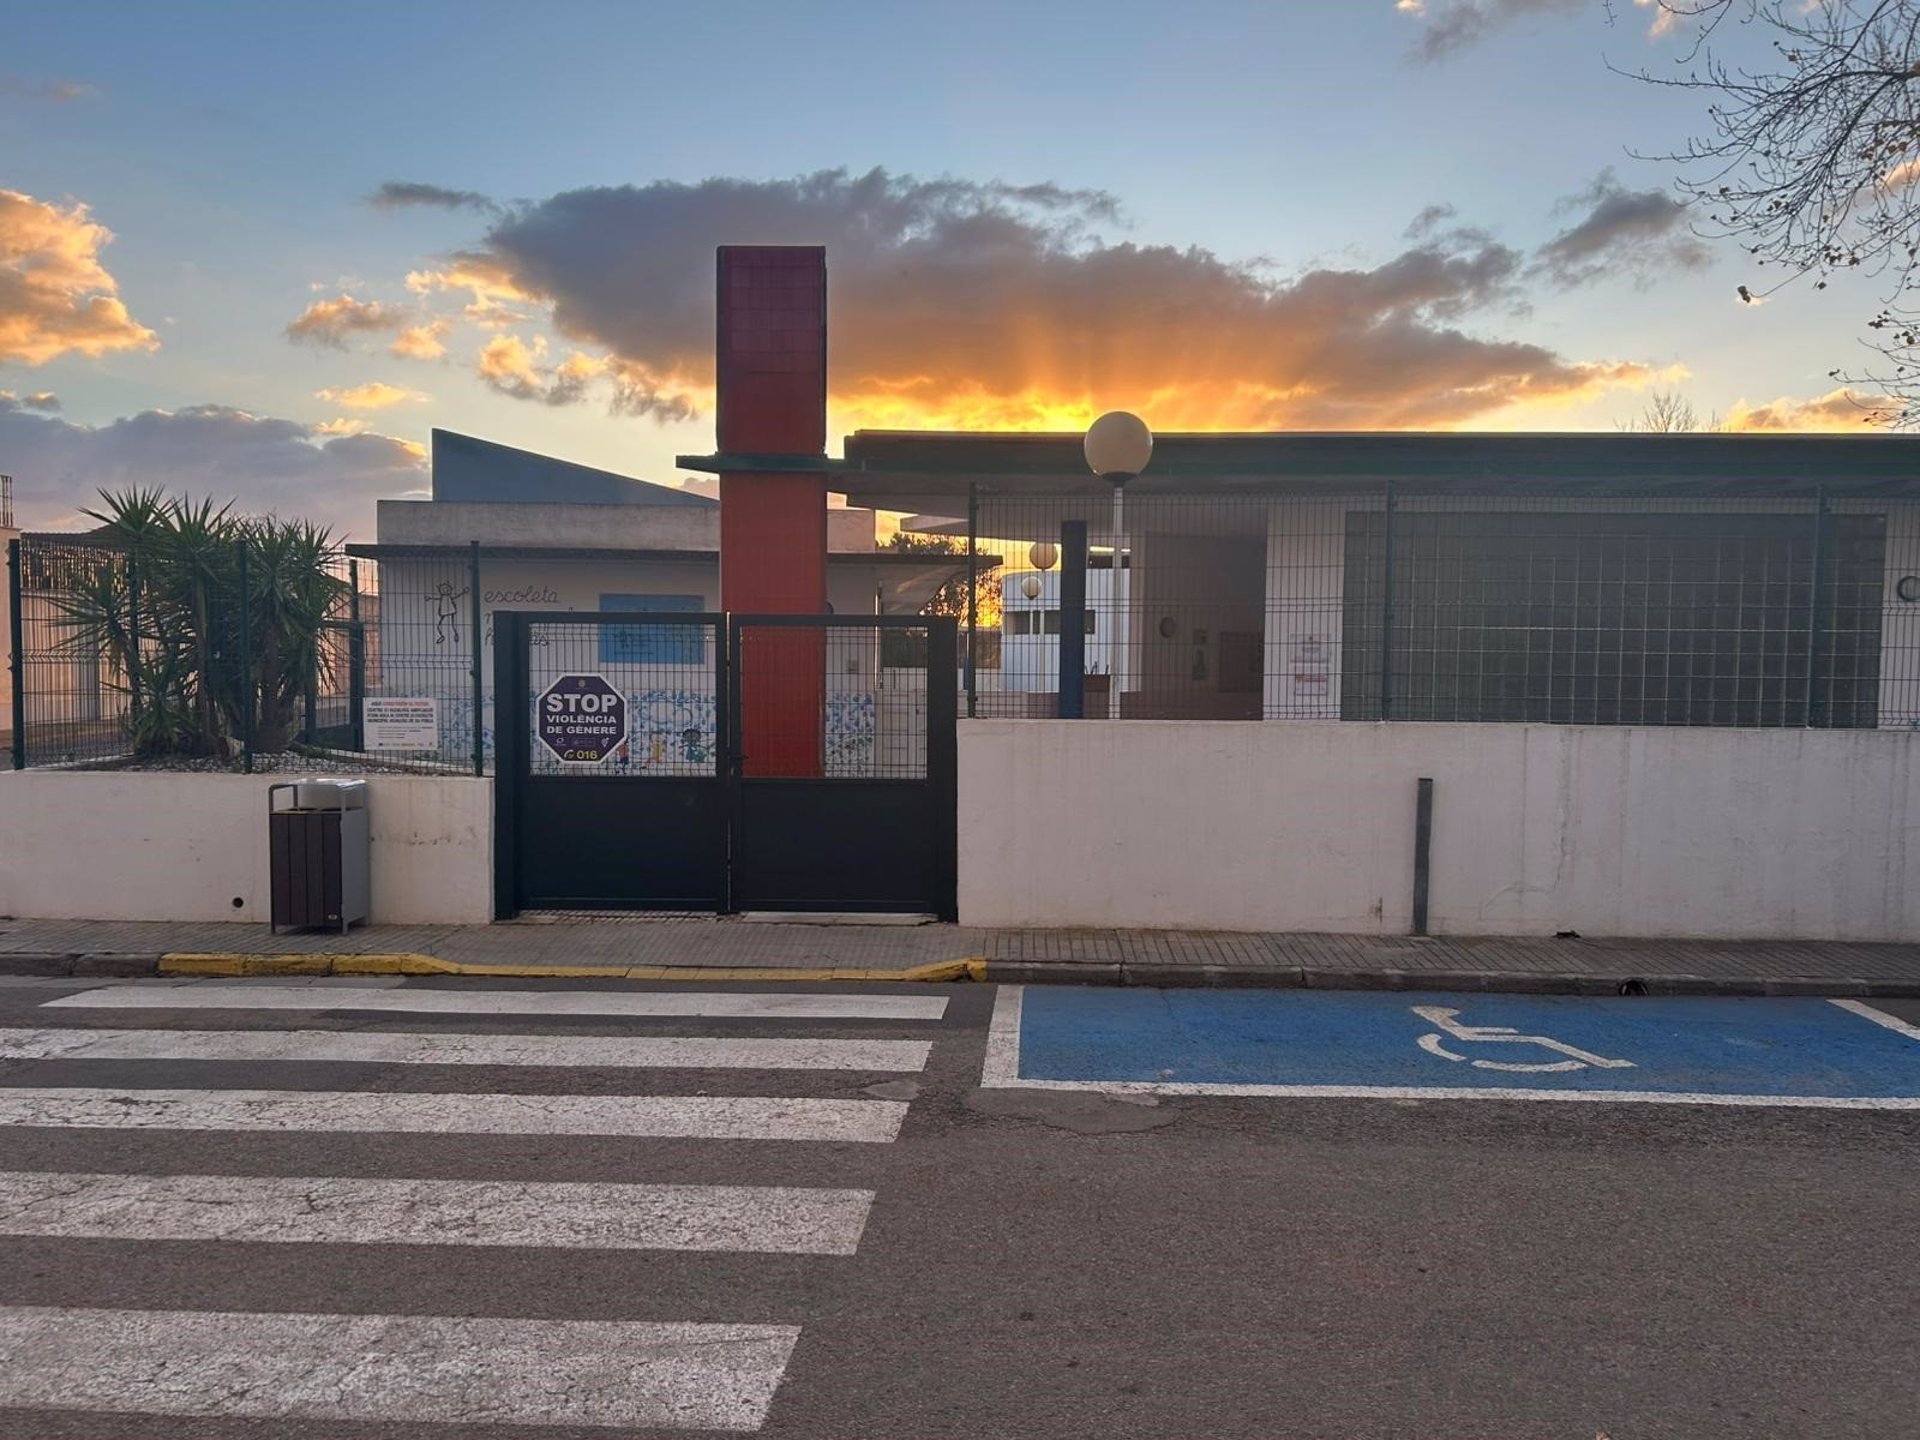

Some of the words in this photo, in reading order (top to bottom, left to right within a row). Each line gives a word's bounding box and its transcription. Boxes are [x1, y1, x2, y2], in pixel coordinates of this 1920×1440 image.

[484, 585, 560, 603] escoleta
[546, 693, 618, 713] STOP
[546, 713, 617, 724] VIOLÈNCIA
[546, 725, 563, 734] DE
[566, 724, 617, 735] GÈNERE
[576, 750, 598, 760] 016
